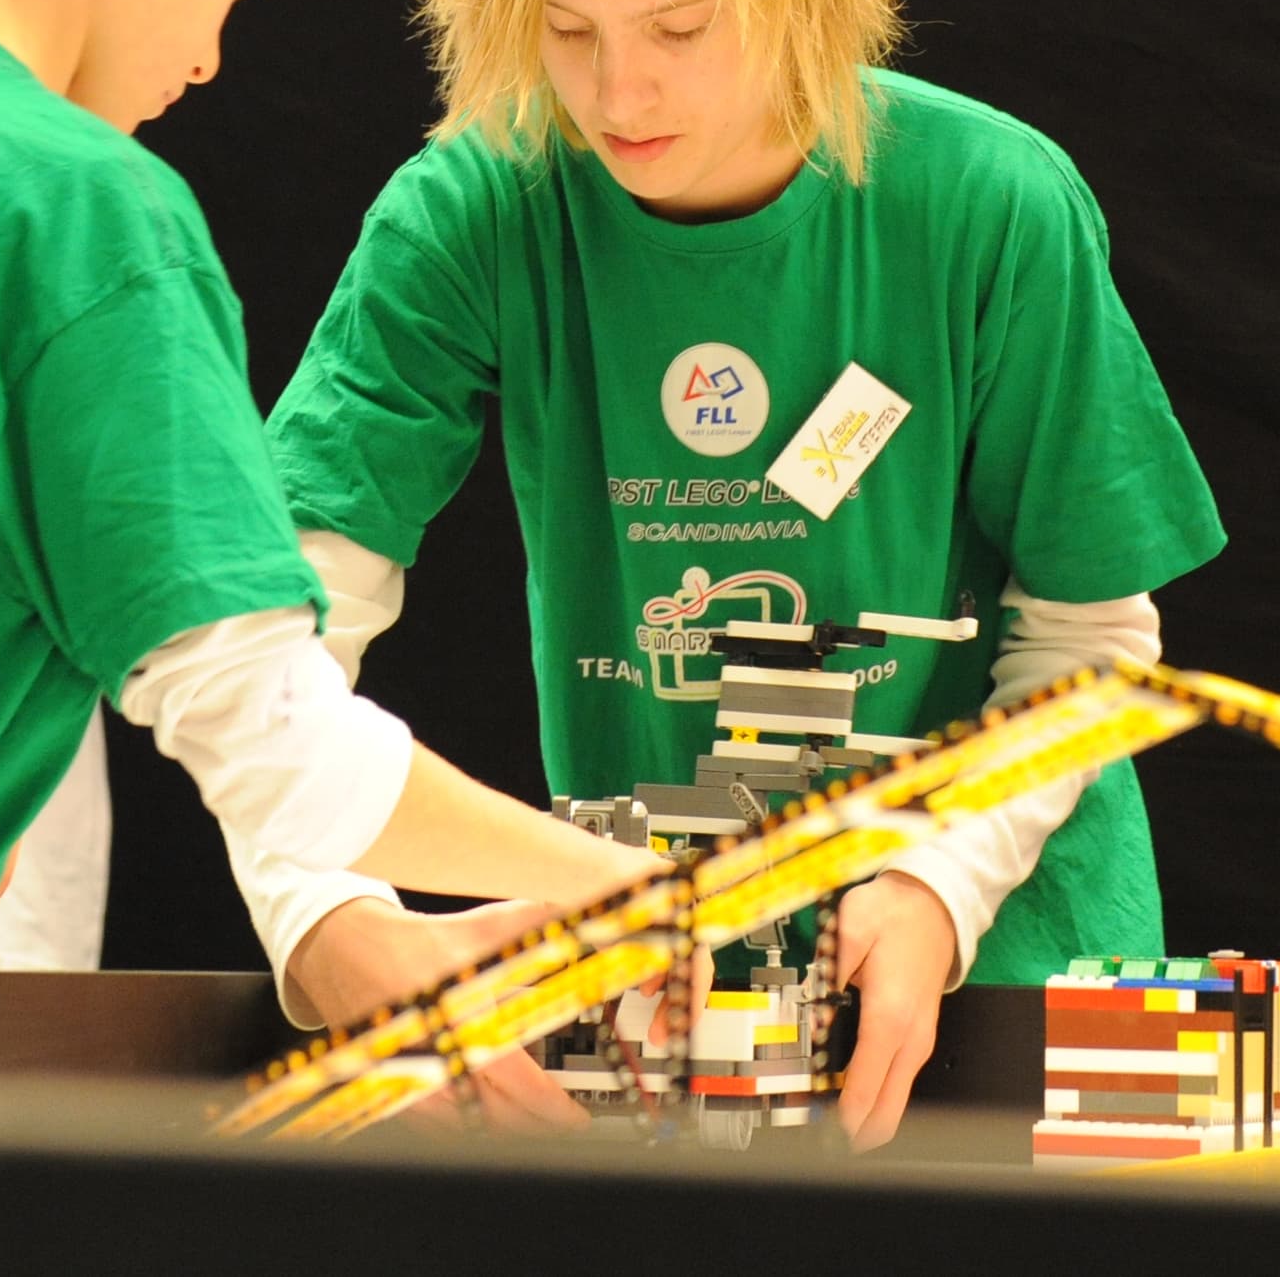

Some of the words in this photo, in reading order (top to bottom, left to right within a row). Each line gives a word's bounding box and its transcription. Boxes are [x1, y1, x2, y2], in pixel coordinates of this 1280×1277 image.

[695, 406, 737, 425] FLL
[858, 407, 899, 454] STEFFEN
[607, 478, 663, 505] RST
[627, 520, 808, 542] SCANDINAVIA
[577, 658, 644, 688] TEAM
[852, 660, 897, 688] 009
